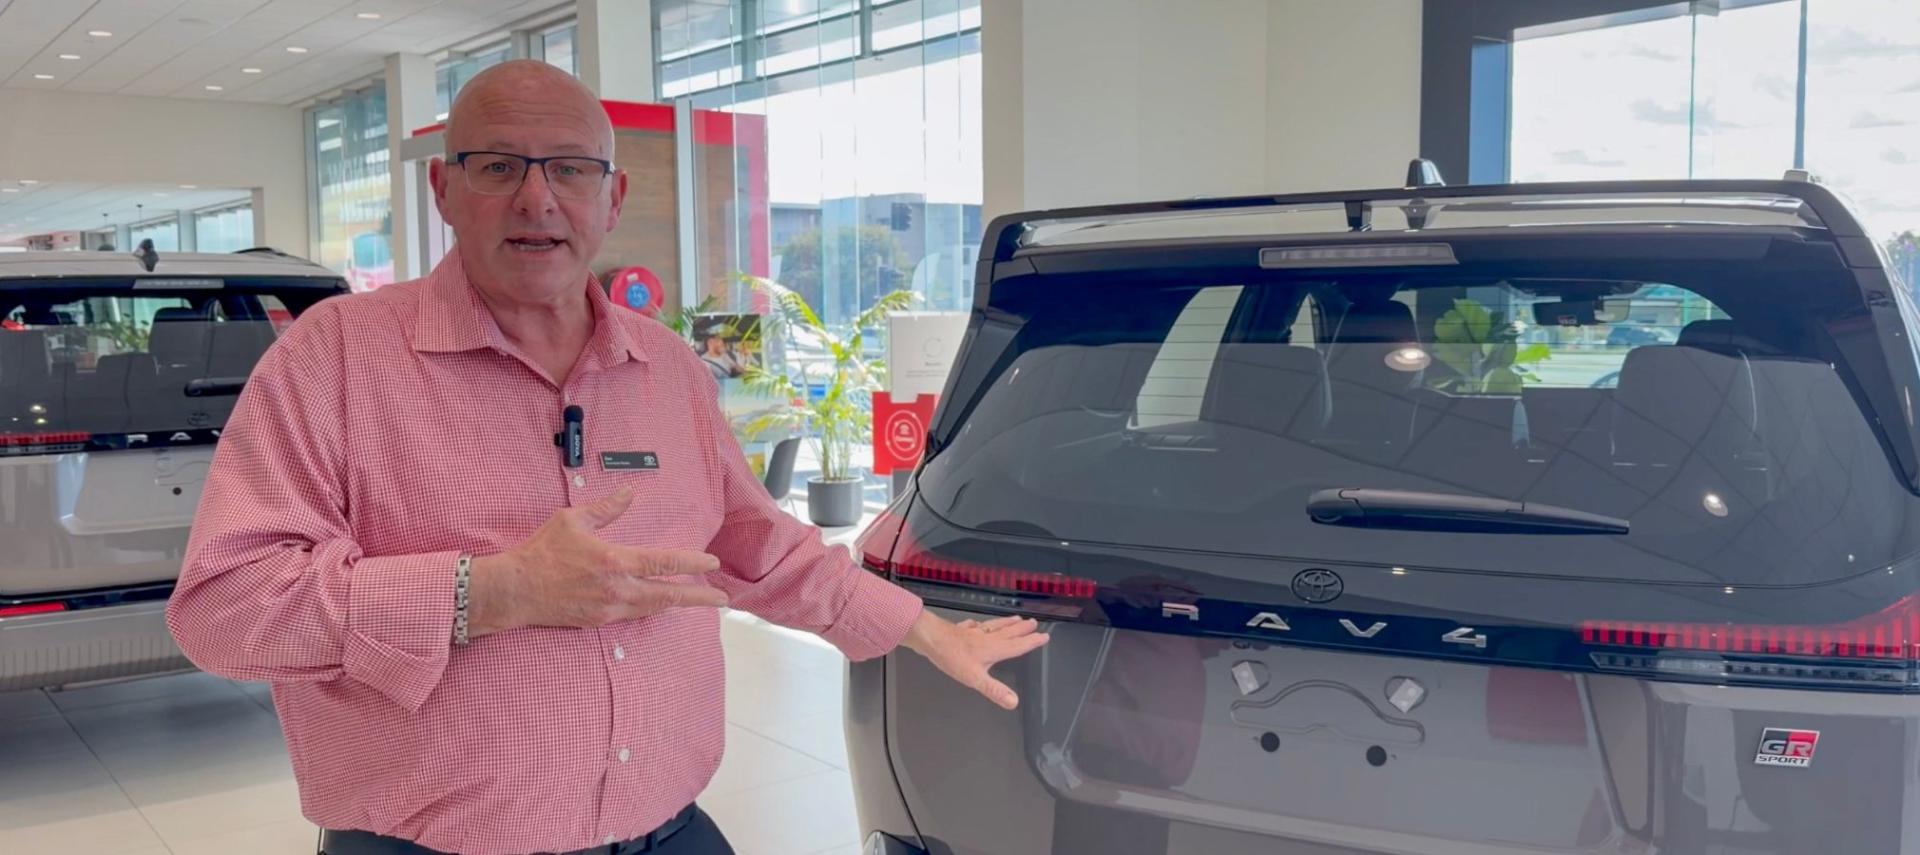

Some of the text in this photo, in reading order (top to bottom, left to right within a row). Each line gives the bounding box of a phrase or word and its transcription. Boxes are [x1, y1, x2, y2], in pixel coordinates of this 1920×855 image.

[1162, 602, 1487, 648] RAV4
[1761, 739, 1813, 758] GR
[1758, 755, 1808, 765] SPORT
